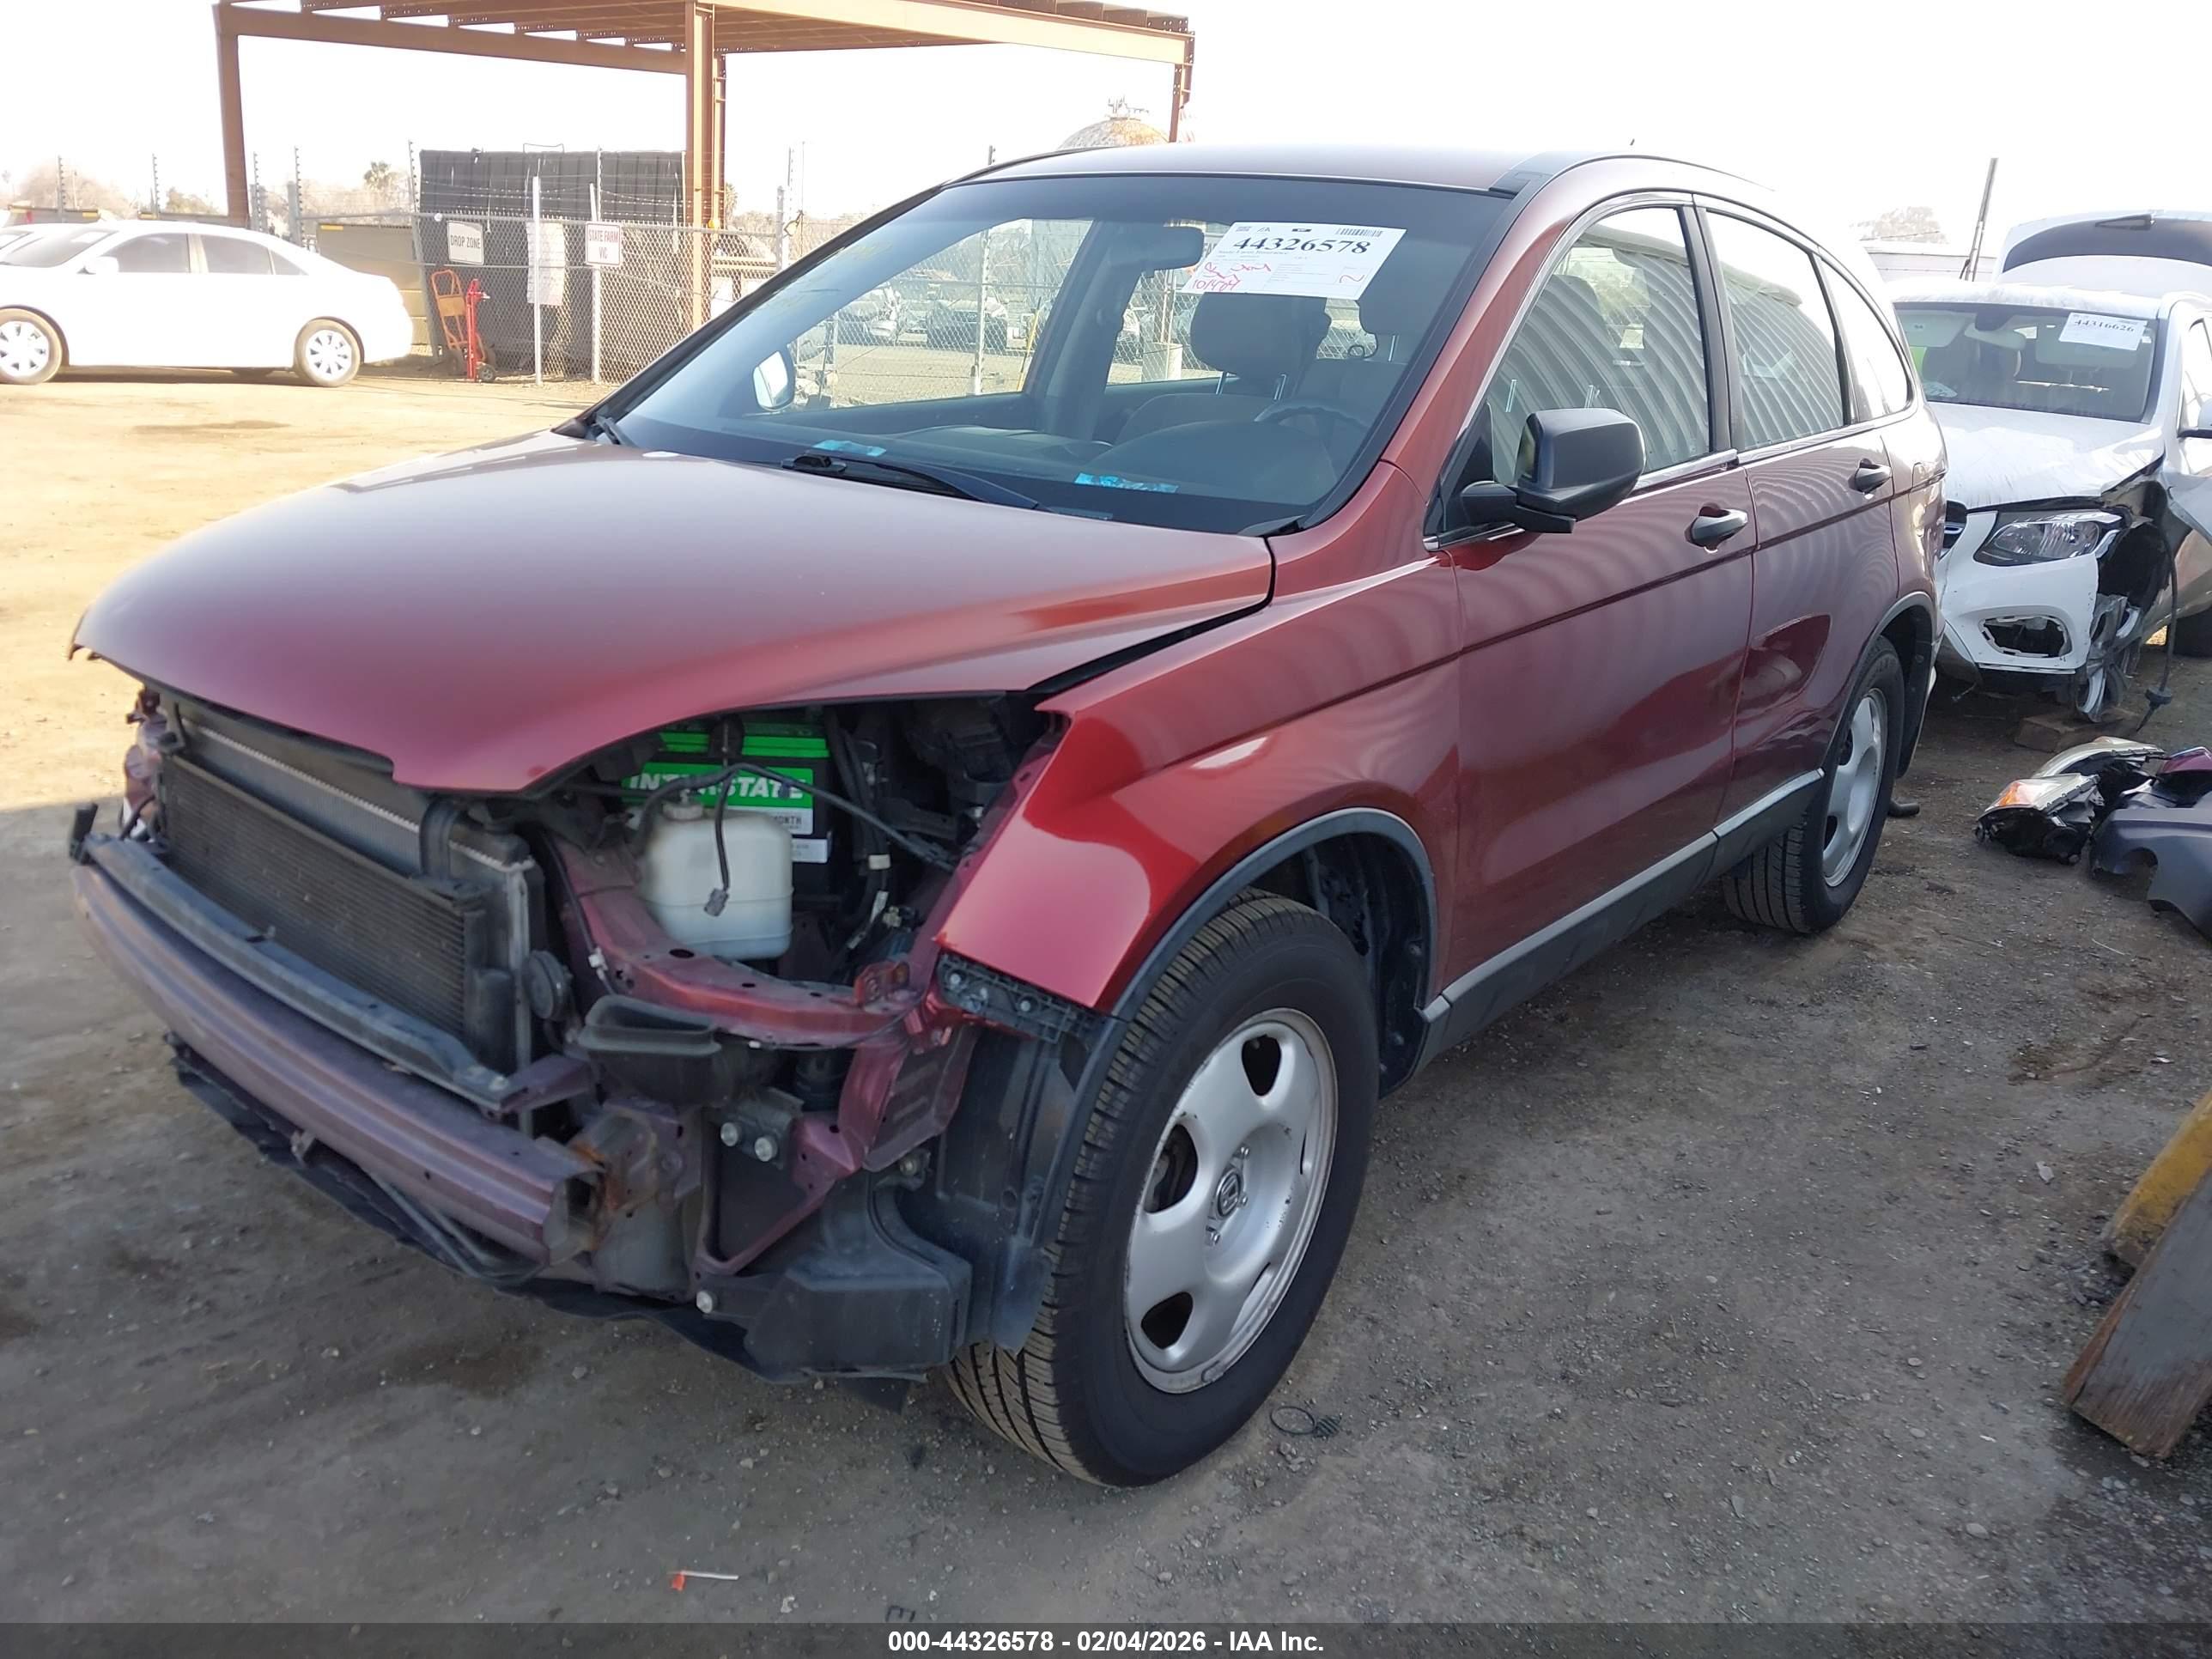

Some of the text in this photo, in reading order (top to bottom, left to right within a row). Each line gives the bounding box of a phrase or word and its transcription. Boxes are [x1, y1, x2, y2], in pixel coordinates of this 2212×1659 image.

[450, 234, 481, 249] DROP ZONE
[588, 229, 618, 243] STATE FARM
[1233, 236, 1371, 255] 44326578
